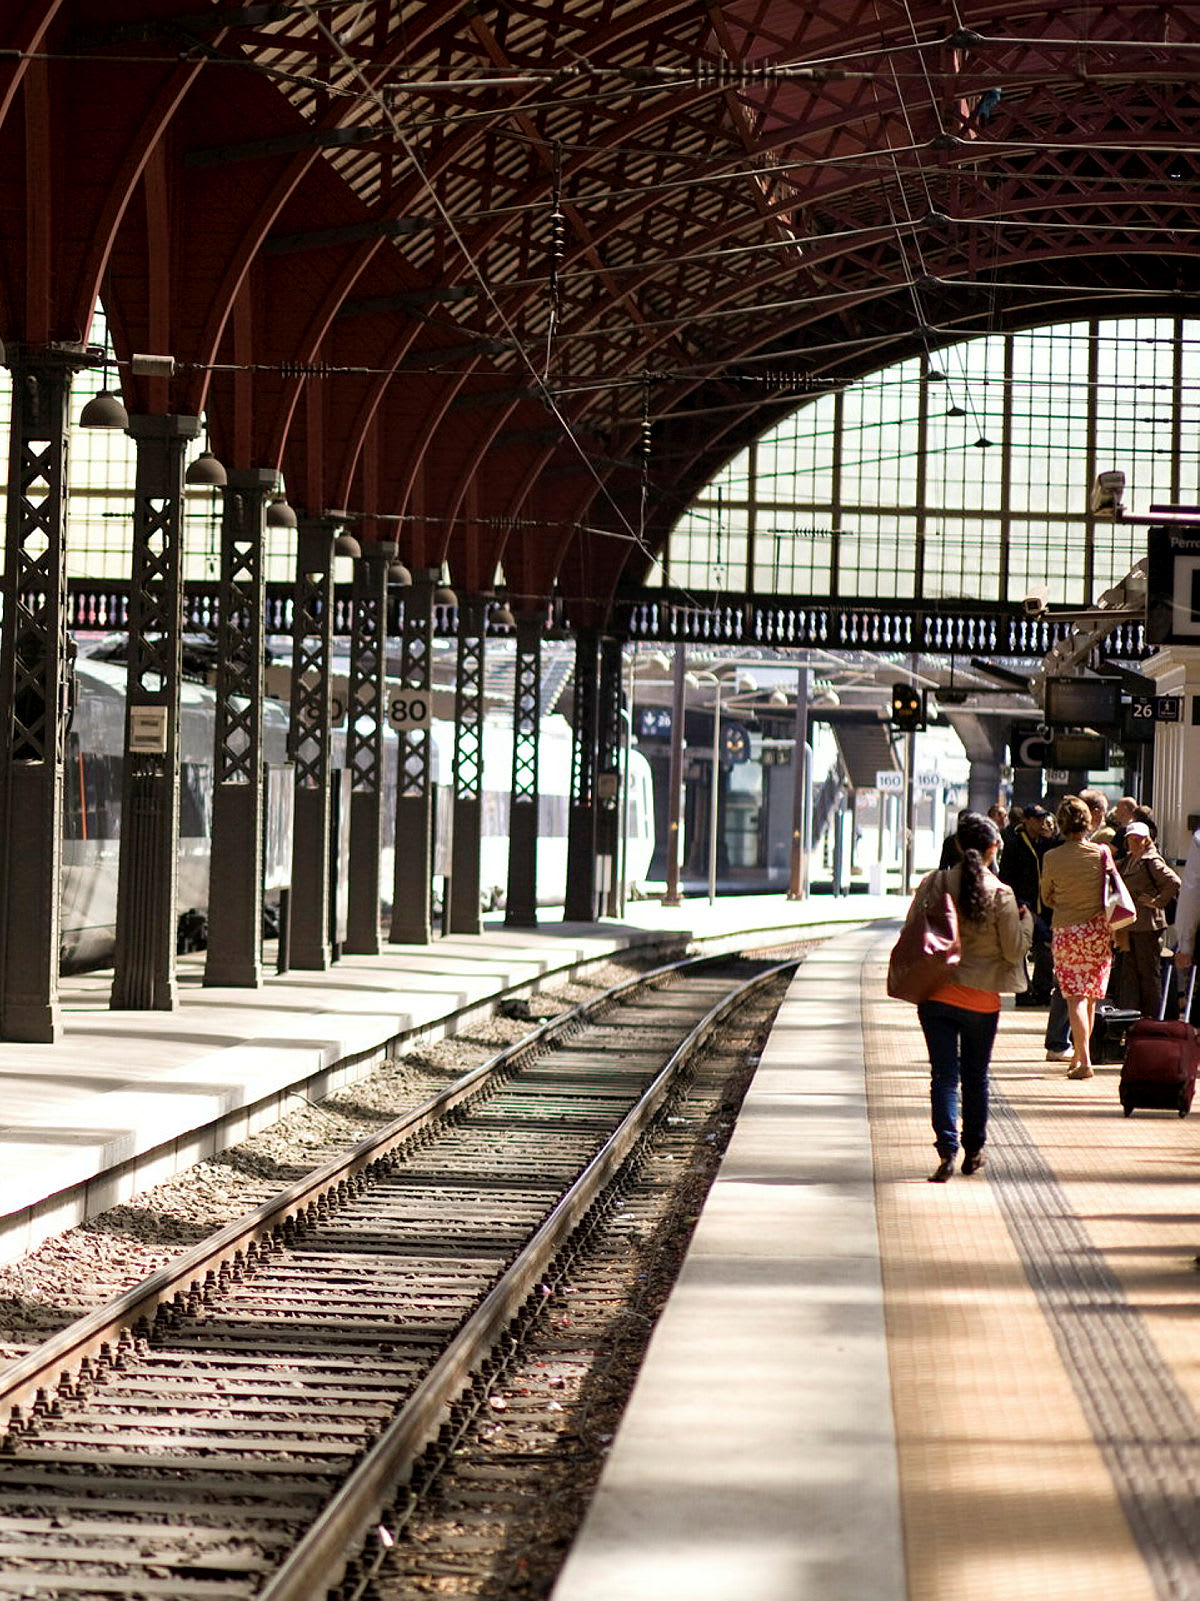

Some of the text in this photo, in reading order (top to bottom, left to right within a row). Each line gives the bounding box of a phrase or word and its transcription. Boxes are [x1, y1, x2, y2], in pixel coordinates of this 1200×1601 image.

[391, 700, 427, 722] 80
[1133, 704, 1153, 718] 26
[879, 775, 901, 786] 160
[919, 774, 940, 785] 160
